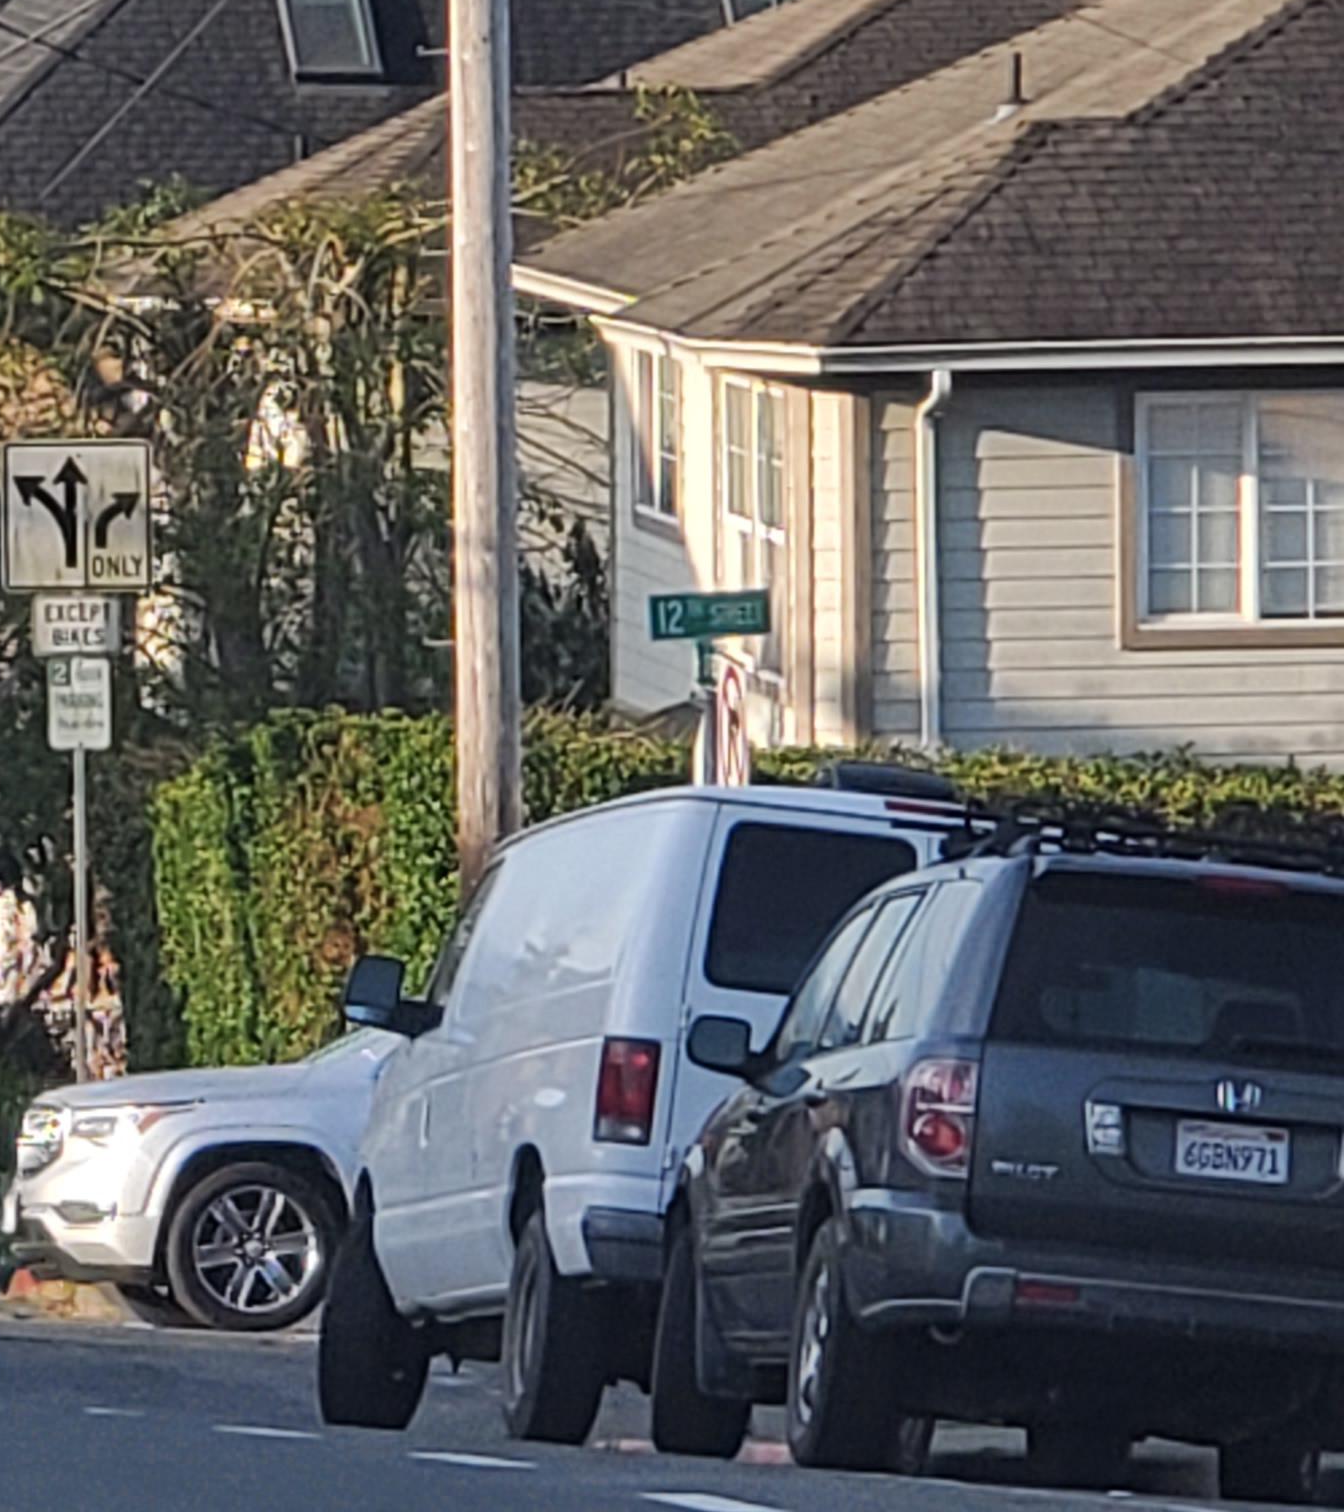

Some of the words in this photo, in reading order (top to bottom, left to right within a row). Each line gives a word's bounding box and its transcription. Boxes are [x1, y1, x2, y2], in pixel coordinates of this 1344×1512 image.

[92, 555, 143, 578] ONLY
[45, 601, 110, 623] EXCEPT
[658, 599, 685, 635] 12
[52, 627, 106, 646] BIKES
[53, 663, 67, 683] 2
[1183, 1141, 1279, 1175] 6GBN971
